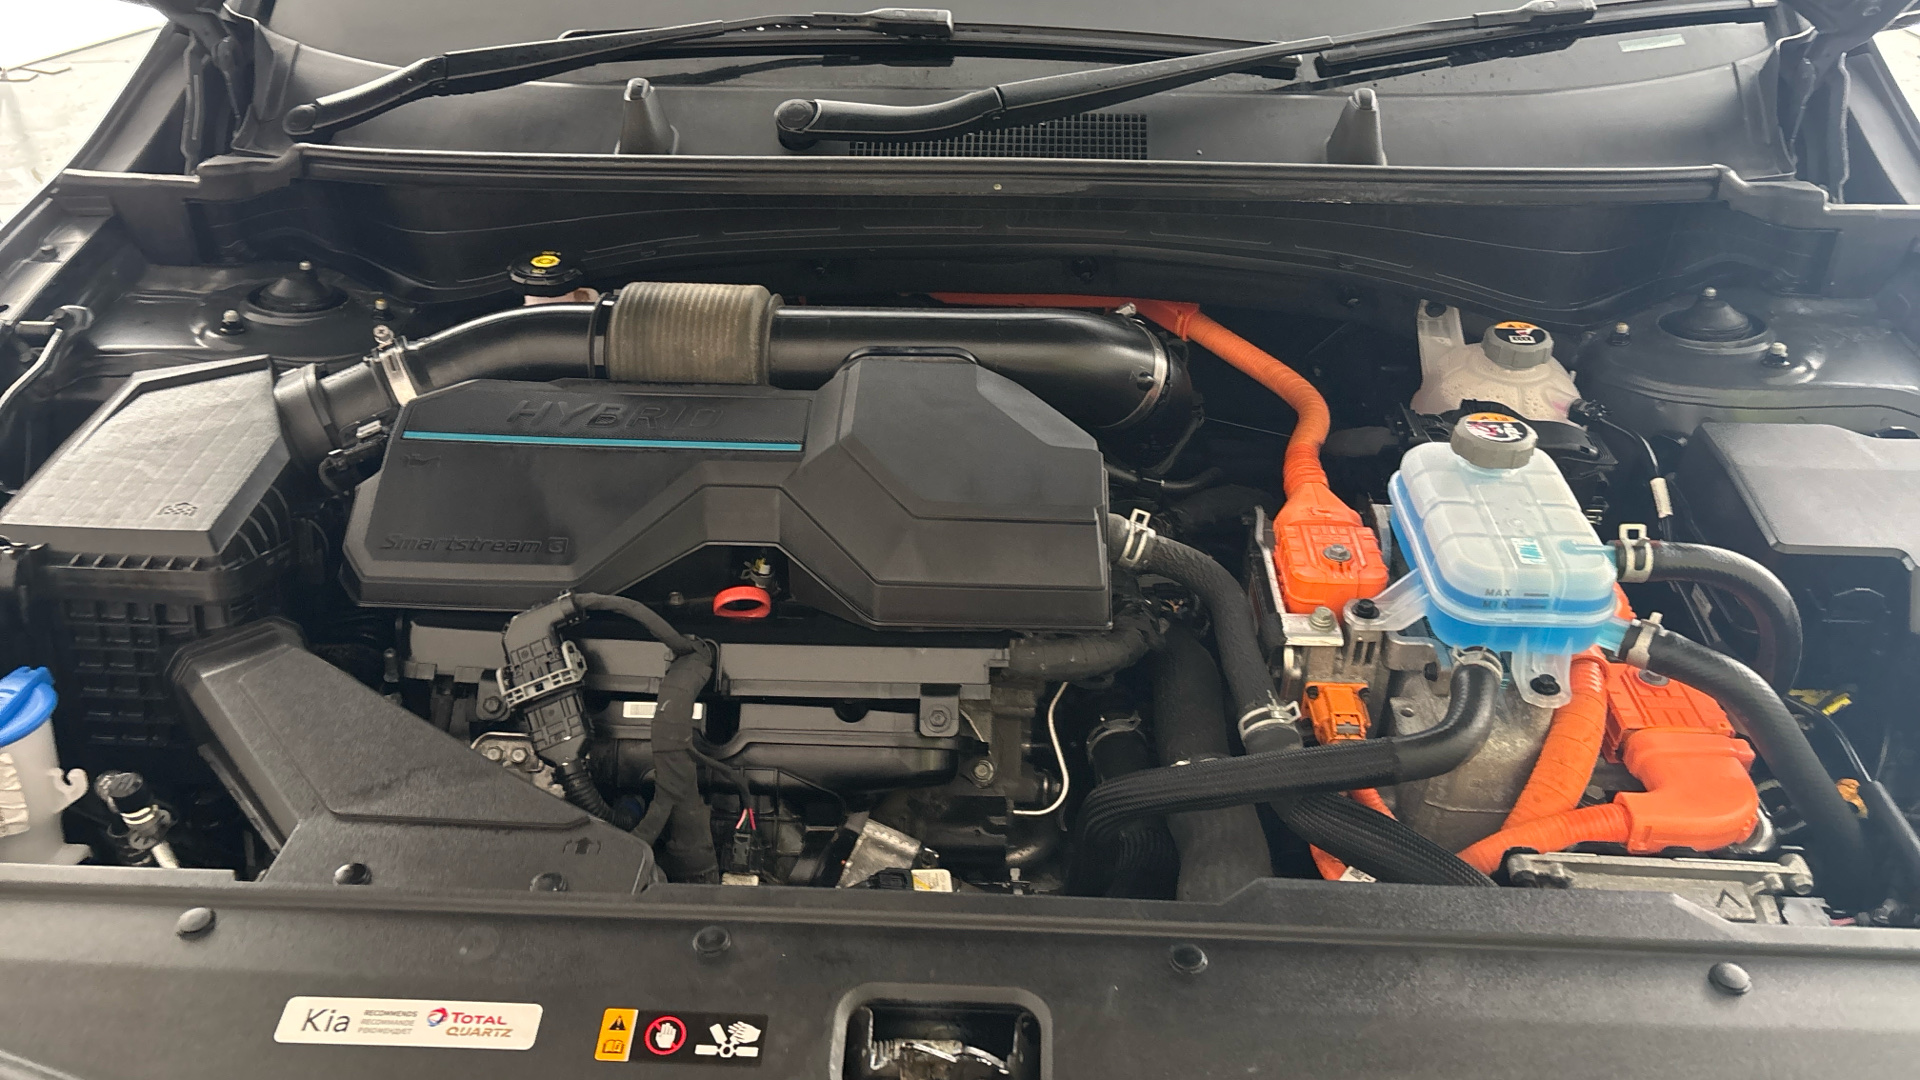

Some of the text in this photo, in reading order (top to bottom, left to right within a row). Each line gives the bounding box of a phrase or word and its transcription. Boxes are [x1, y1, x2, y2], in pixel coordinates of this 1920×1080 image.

[507, 399, 724, 429] HYBRID
[379, 532, 543, 553] Smartstream
[1484, 588, 1512, 597] MAX
[301, 1008, 350, 1033] Kia
[363, 1009, 418, 1017] RECOMMENDS
[451, 1011, 508, 1026] TOTAL
[445, 1026, 514, 1038] QUARTZ
